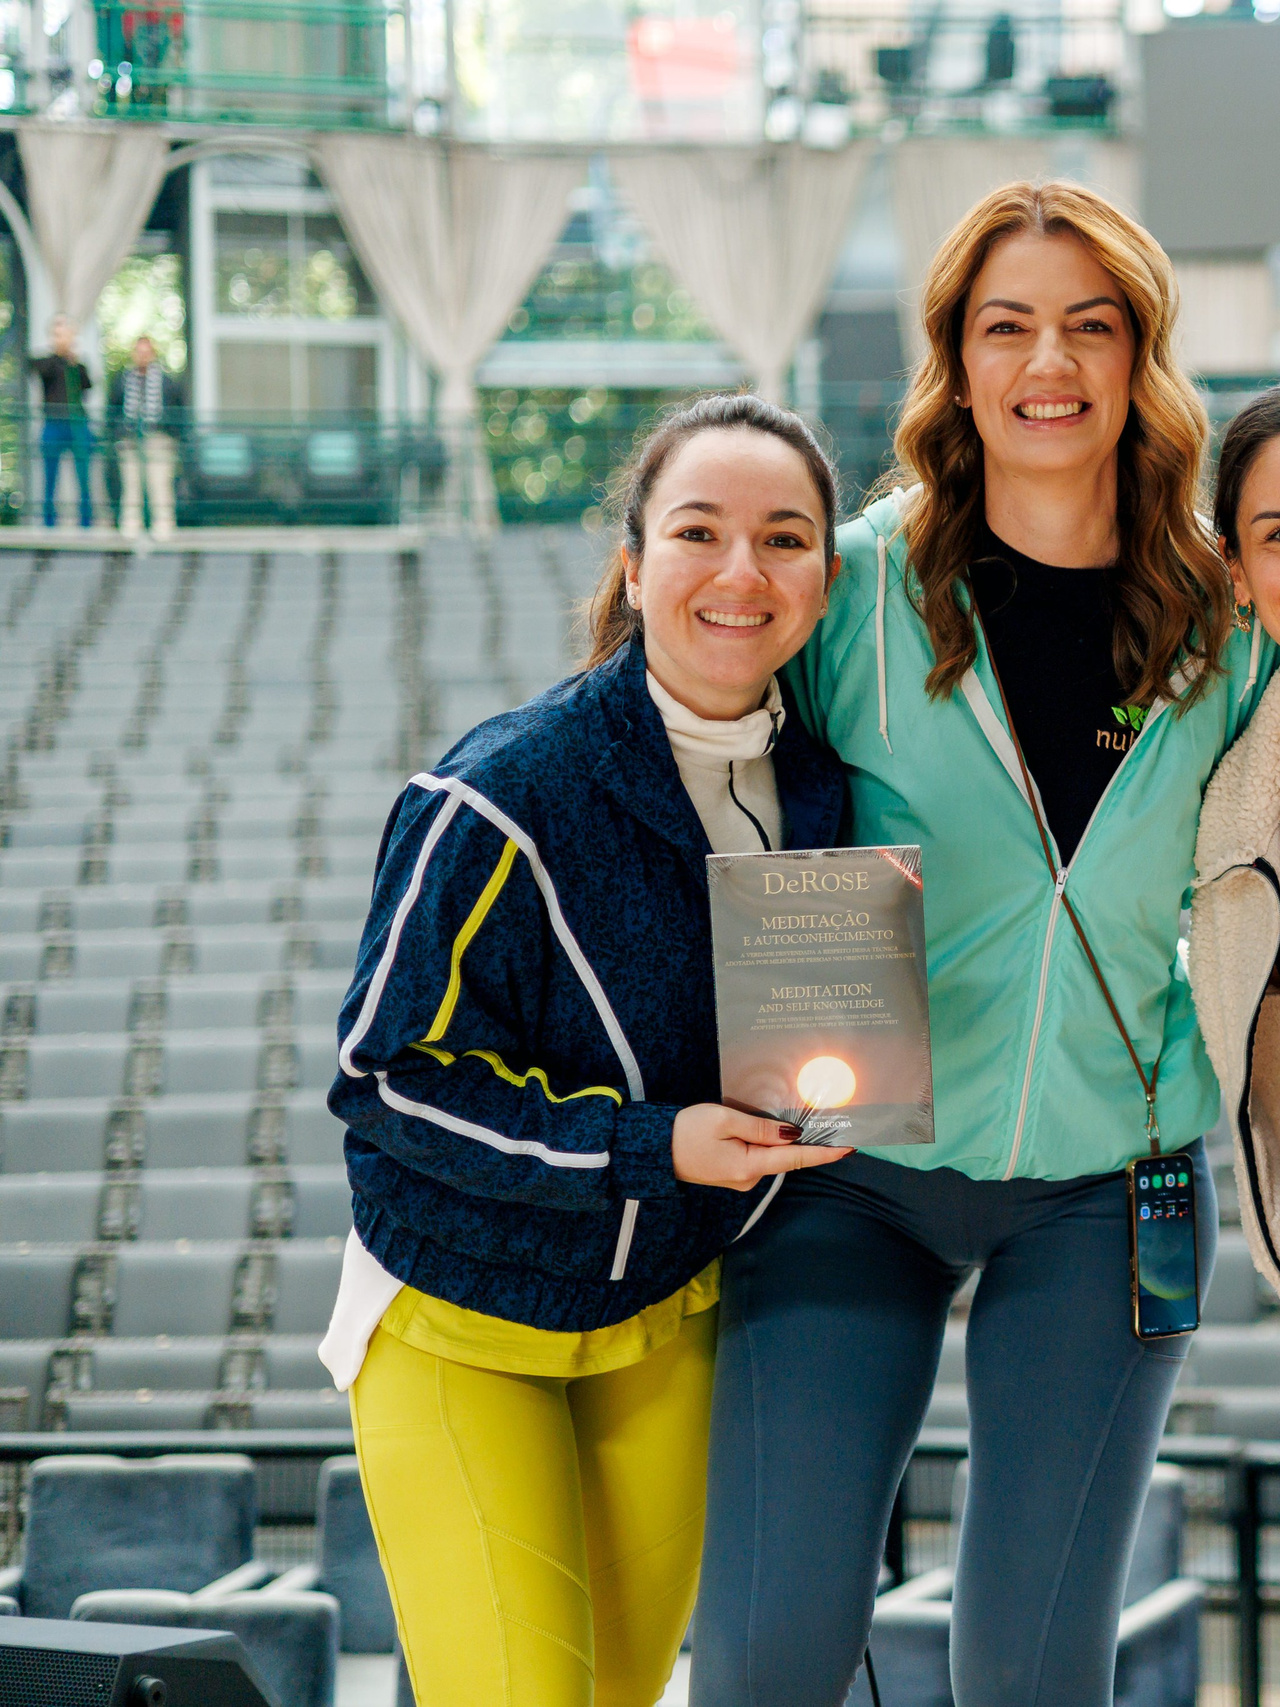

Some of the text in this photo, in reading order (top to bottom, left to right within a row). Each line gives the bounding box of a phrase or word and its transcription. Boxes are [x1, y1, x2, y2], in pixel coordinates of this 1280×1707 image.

[761, 870, 871, 895] DeROSE
[761, 909, 870, 931] MEDITAÇÃO
[743, 929, 894, 947] E AUTOCONHECIMENTO
[775, 949, 816, 957] DESVENDADA
[823, 947, 851, 955] RESPEITO
[770, 983, 873, 1000] MEDITATION
[758, 998, 885, 1014] AND SELF KNOWLEDGE
